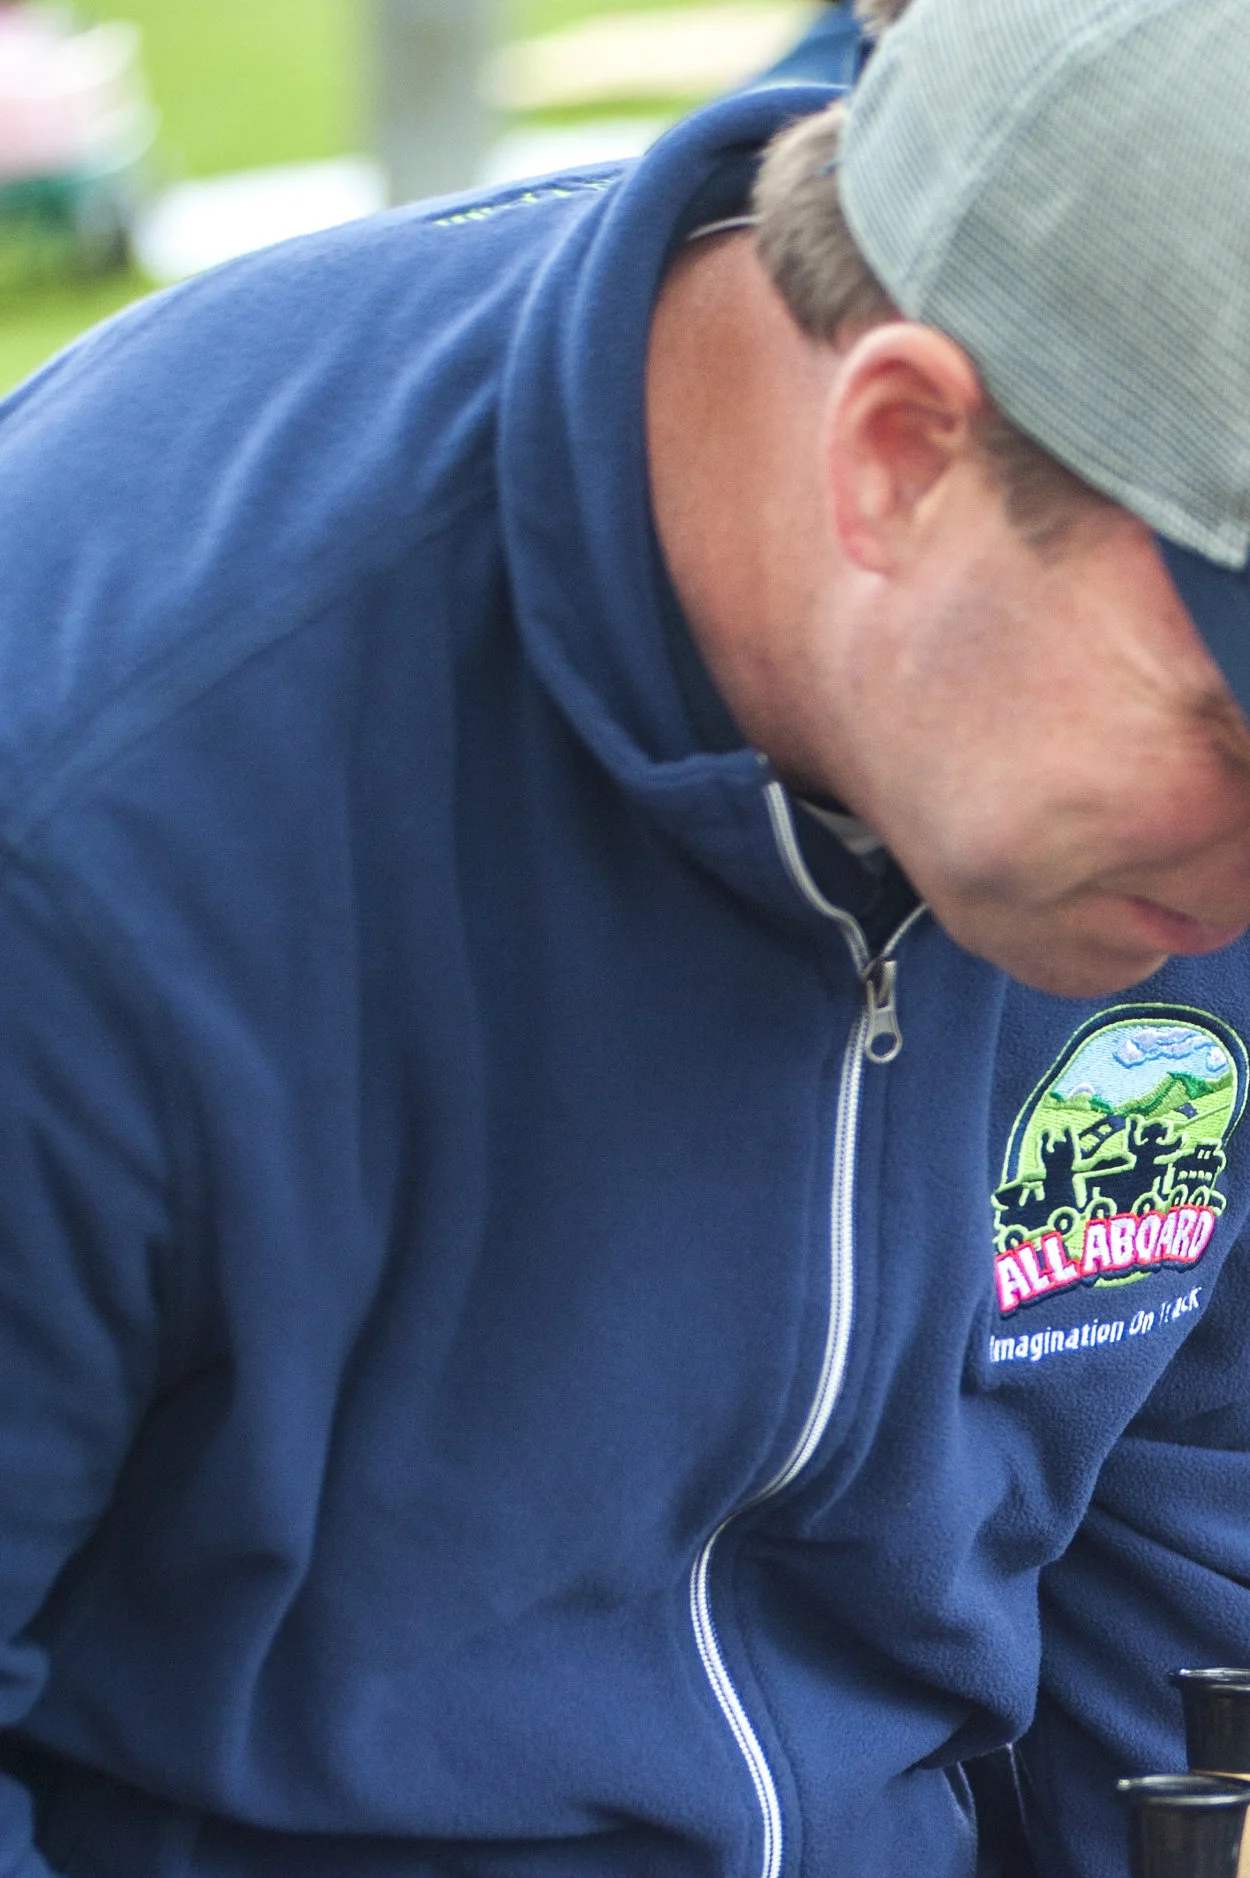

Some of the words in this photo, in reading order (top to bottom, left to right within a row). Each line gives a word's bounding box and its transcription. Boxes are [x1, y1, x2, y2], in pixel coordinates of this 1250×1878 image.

[996, 1233, 1079, 1312] ALL
[1082, 1207, 1214, 1273] ABOARD
[989, 1318, 1125, 1363] Imagination
[1128, 1310, 1155, 1335] On
